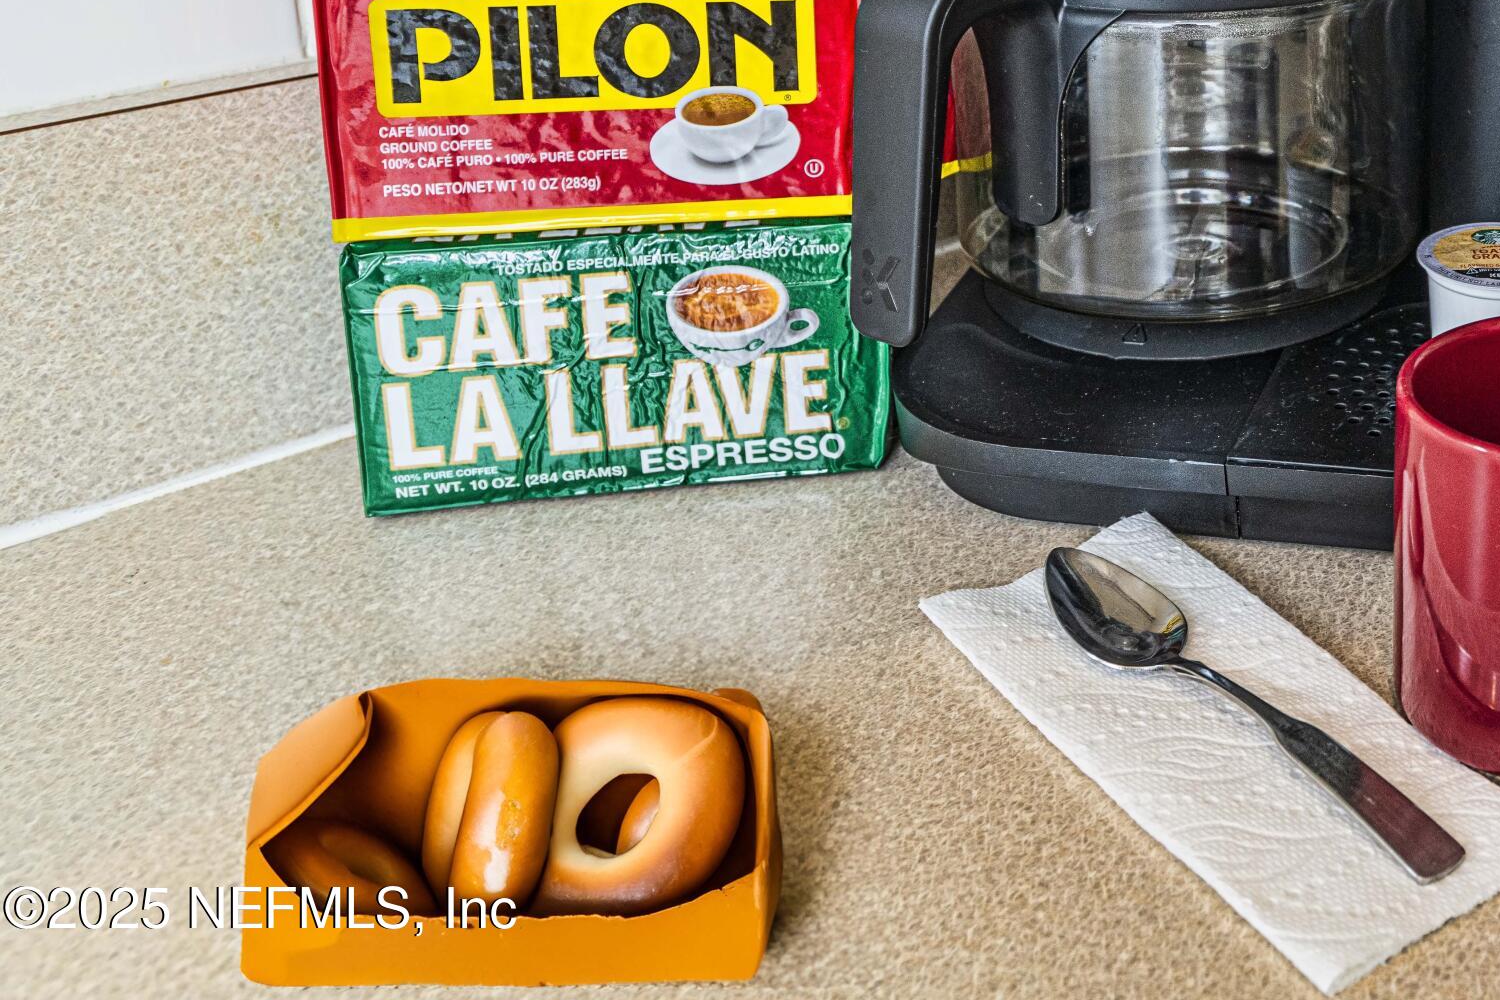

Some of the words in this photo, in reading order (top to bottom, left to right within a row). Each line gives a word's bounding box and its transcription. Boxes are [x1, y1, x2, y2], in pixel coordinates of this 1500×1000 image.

[378, 123, 414, 139] CAFÉ
[417, 123, 470, 138] MOLIDO
[379, 140, 438, 155] GROUND
[439, 138, 494, 152] COFFEE
[380, 157, 415, 171] 100%
[417, 153, 453, 169] CAFÉ
[456, 154, 494, 167] PURO
[504, 152, 538, 165] 100%
[539, 150, 574, 163] PURE
[577, 148, 629, 161] COFFEE
[382, 183, 422, 198] PESO
[425, 180, 494, 196] NETO/NET
[495, 179, 518, 193] WT
[520, 178, 536, 192] 10
[538, 177, 558, 191] OZ
[561, 175, 602, 193] (283g)
[498, 260, 563, 276] TOSTADO
[567, 252, 679, 272] ESPECIALMENTE
[682, 250, 718, 265] PARA
[741, 245, 789, 261] GUSTO
[791, 243, 840, 257] LATINO
[373, 270, 638, 378] CAFE
[381, 374, 523, 471] LA
[546, 348, 834, 456] LLAVE
[640, 433, 846, 476] ESPRESSO
[391, 473, 422, 484] 100%
[423, 469, 454, 481] PURE
[455, 465, 499, 478] COFFEE
[394, 485, 430, 500] NET
[433, 480, 465, 495] WT.
[469, 479, 488, 492] 10
[491, 476, 521, 490] OZ.
[524, 473, 559, 489] (284
[562, 465, 628, 483] GRAMS)
